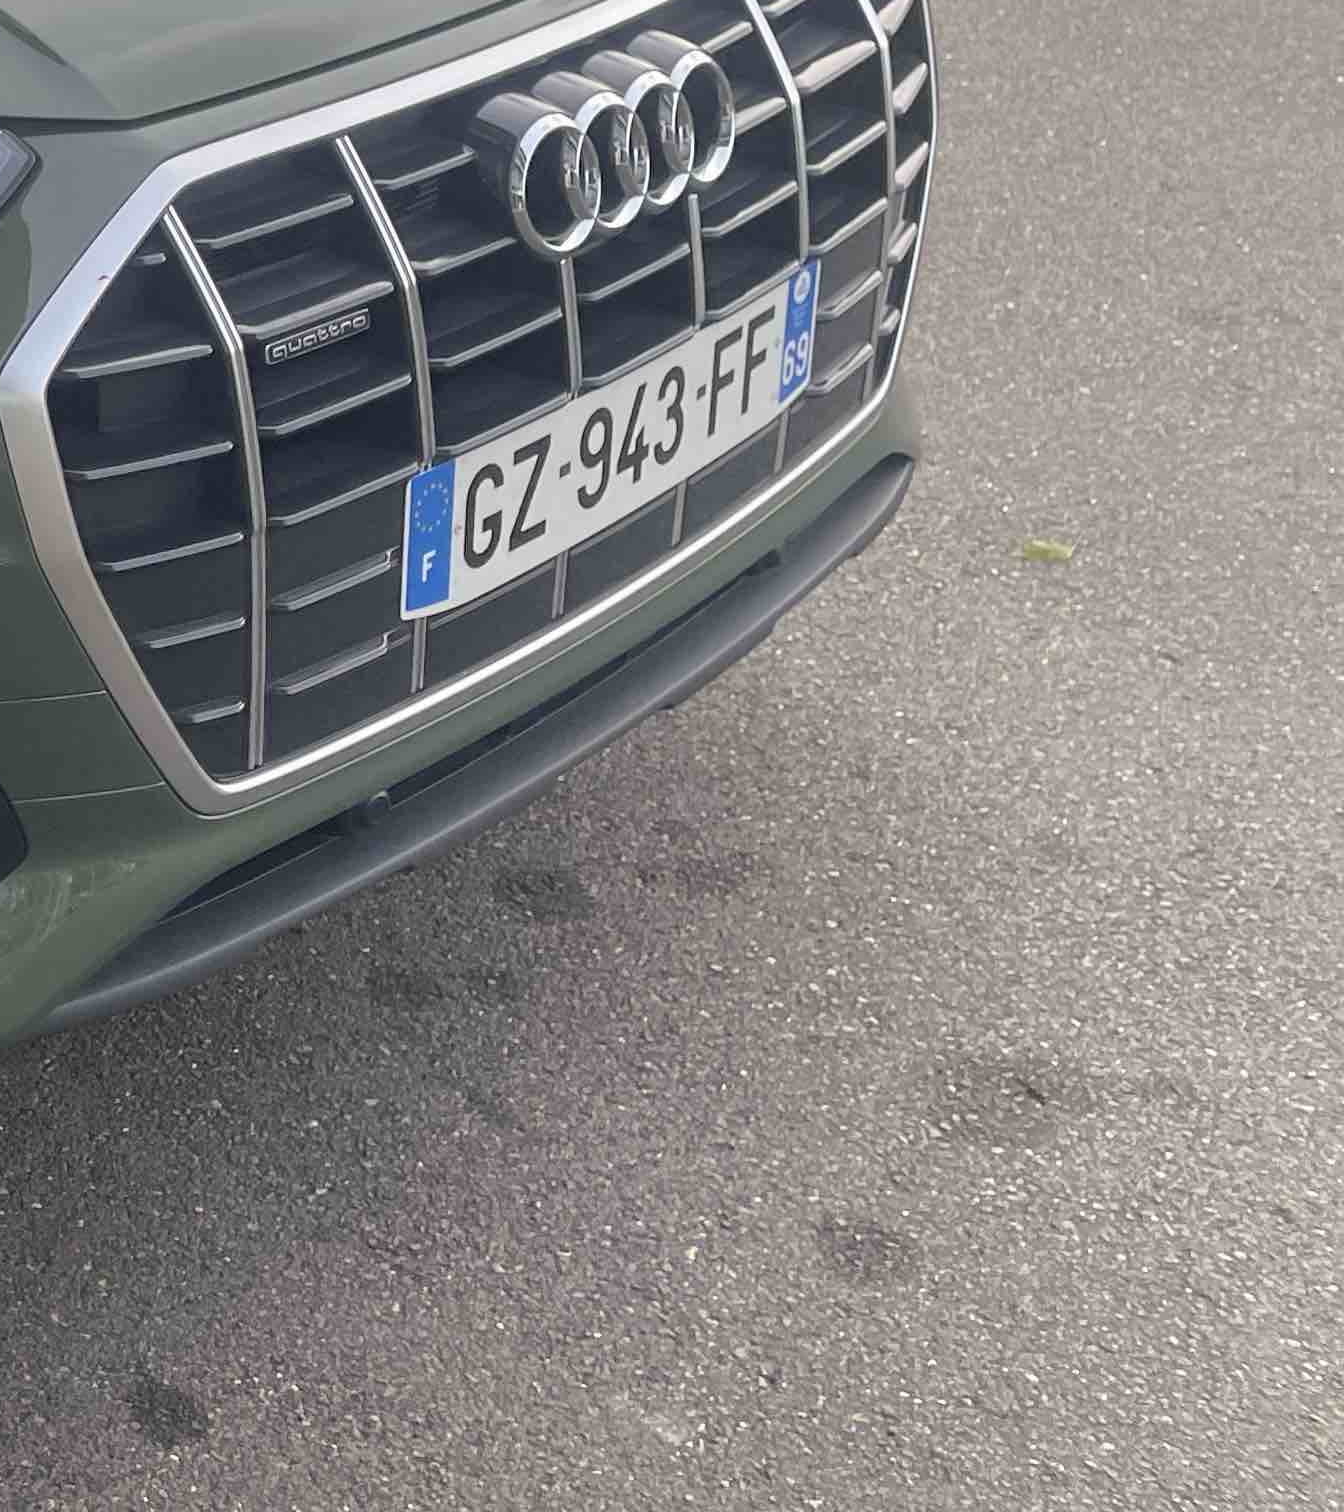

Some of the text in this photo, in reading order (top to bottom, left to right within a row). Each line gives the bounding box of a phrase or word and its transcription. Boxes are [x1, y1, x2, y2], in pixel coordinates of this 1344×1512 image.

[272, 314, 367, 360] quattro
[782, 330, 810, 386] 69
[463, 305, 776, 569] GZ-943-FF
[421, 549, 438, 584] F
